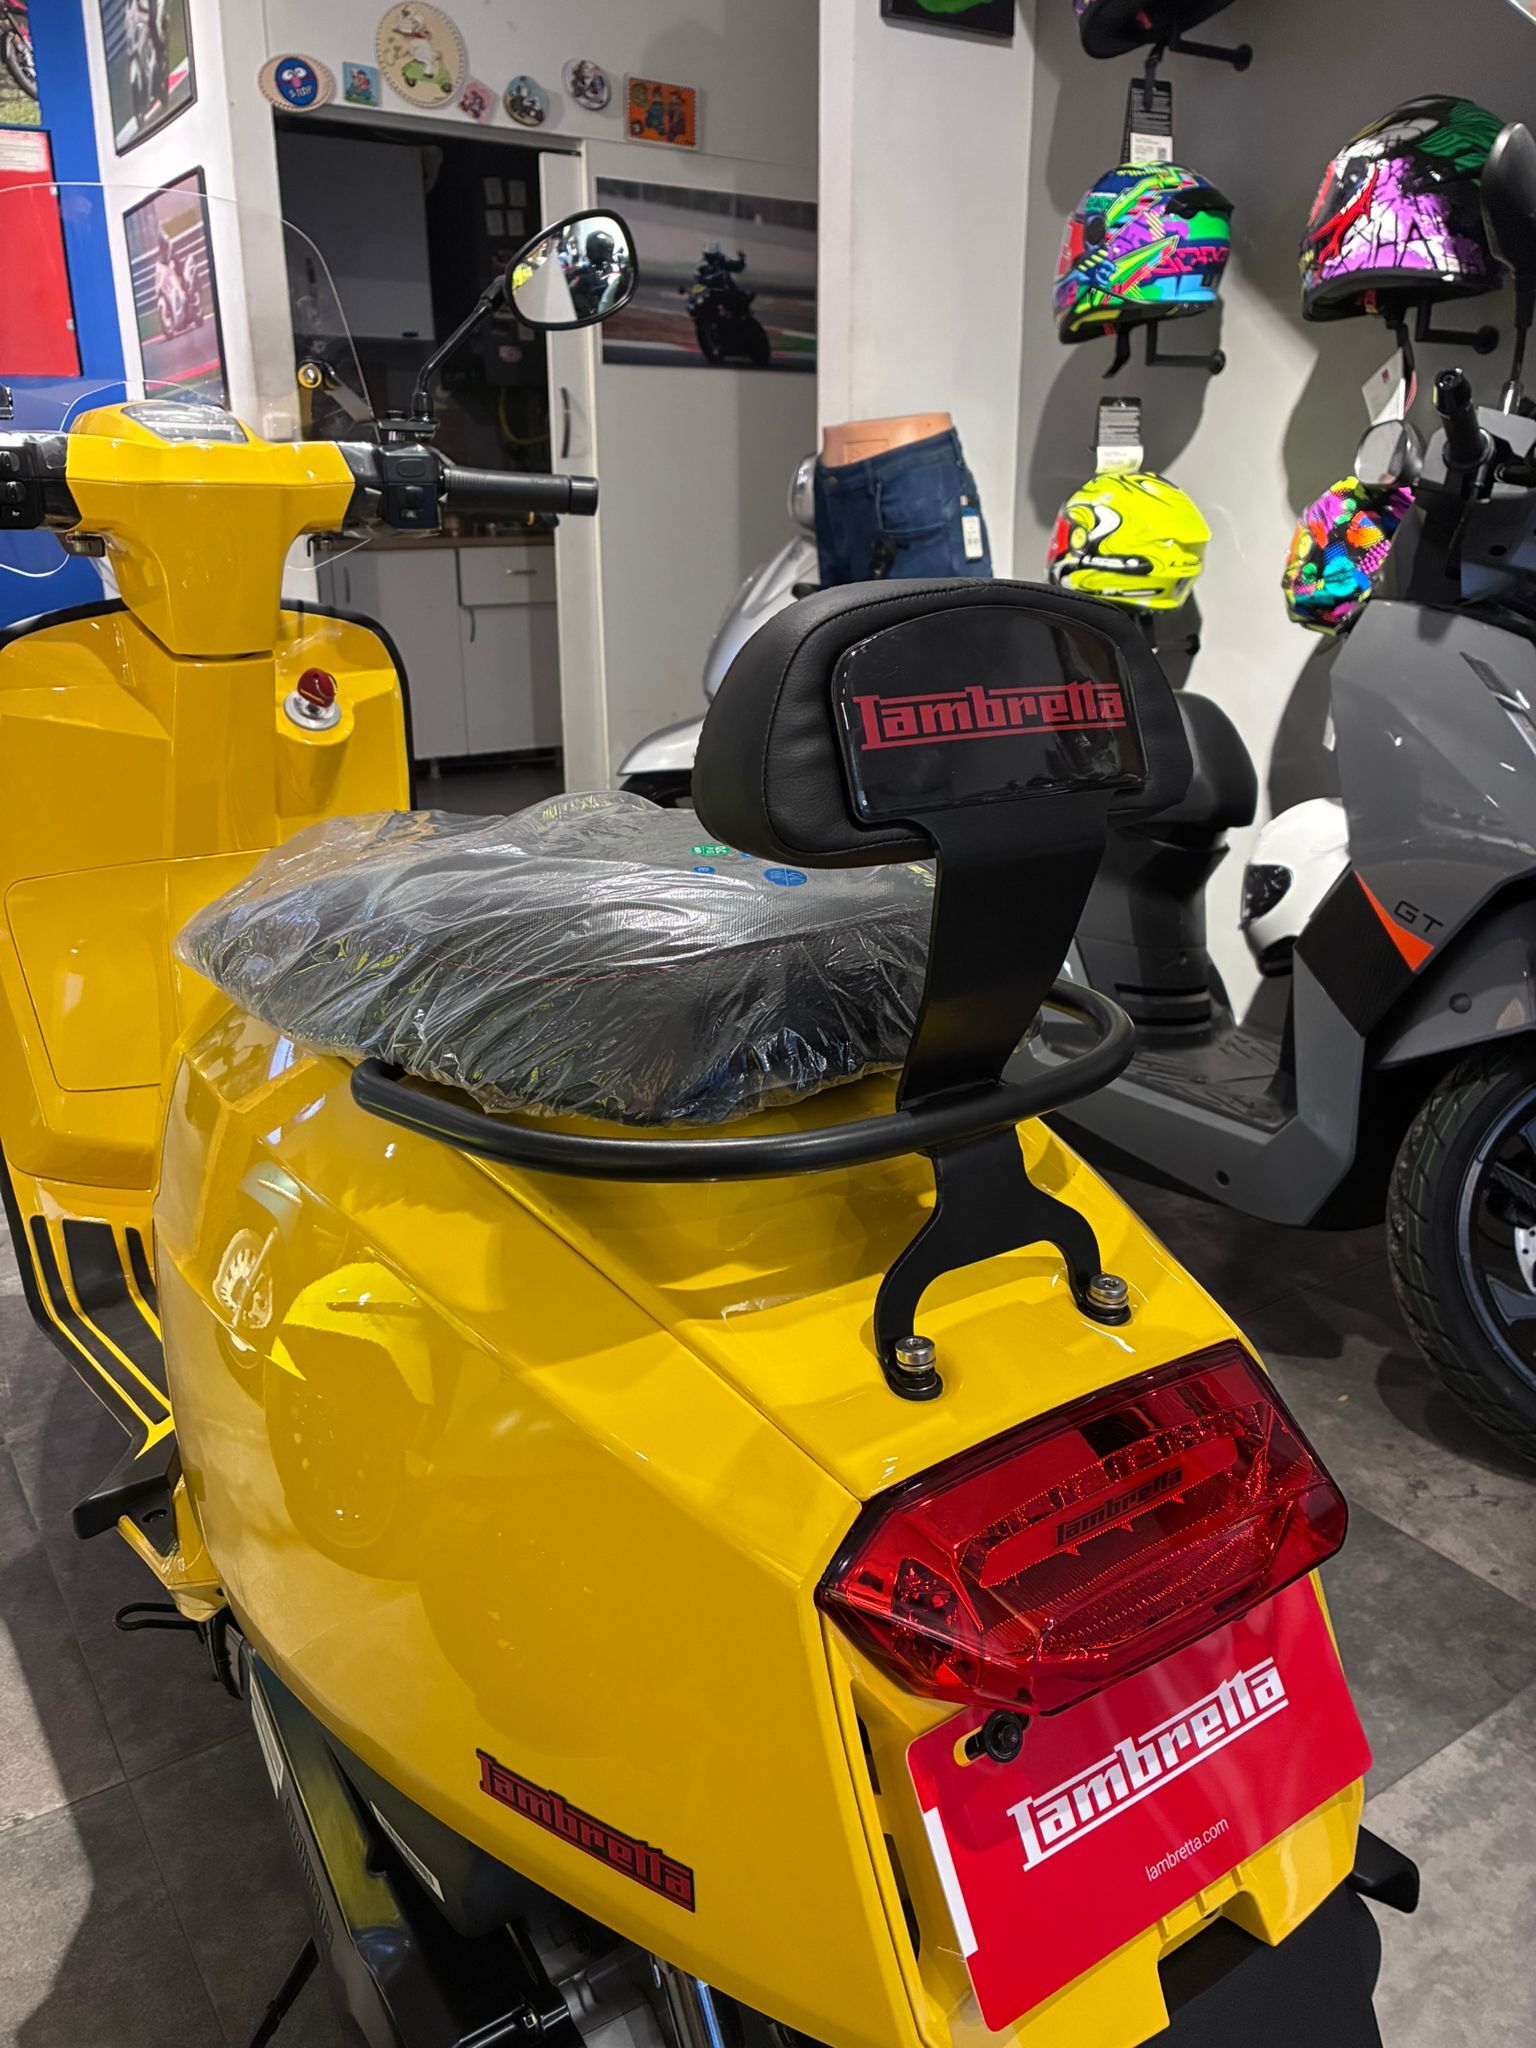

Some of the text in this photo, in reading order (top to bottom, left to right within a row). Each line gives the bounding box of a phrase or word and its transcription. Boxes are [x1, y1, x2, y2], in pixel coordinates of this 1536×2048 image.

[853, 681, 1127, 750] Lambretta
[1394, 900, 1444, 933] GT
[1007, 1657, 1288, 1872] Lambretta
[1145, 1817, 1229, 1881] lambretta.com
